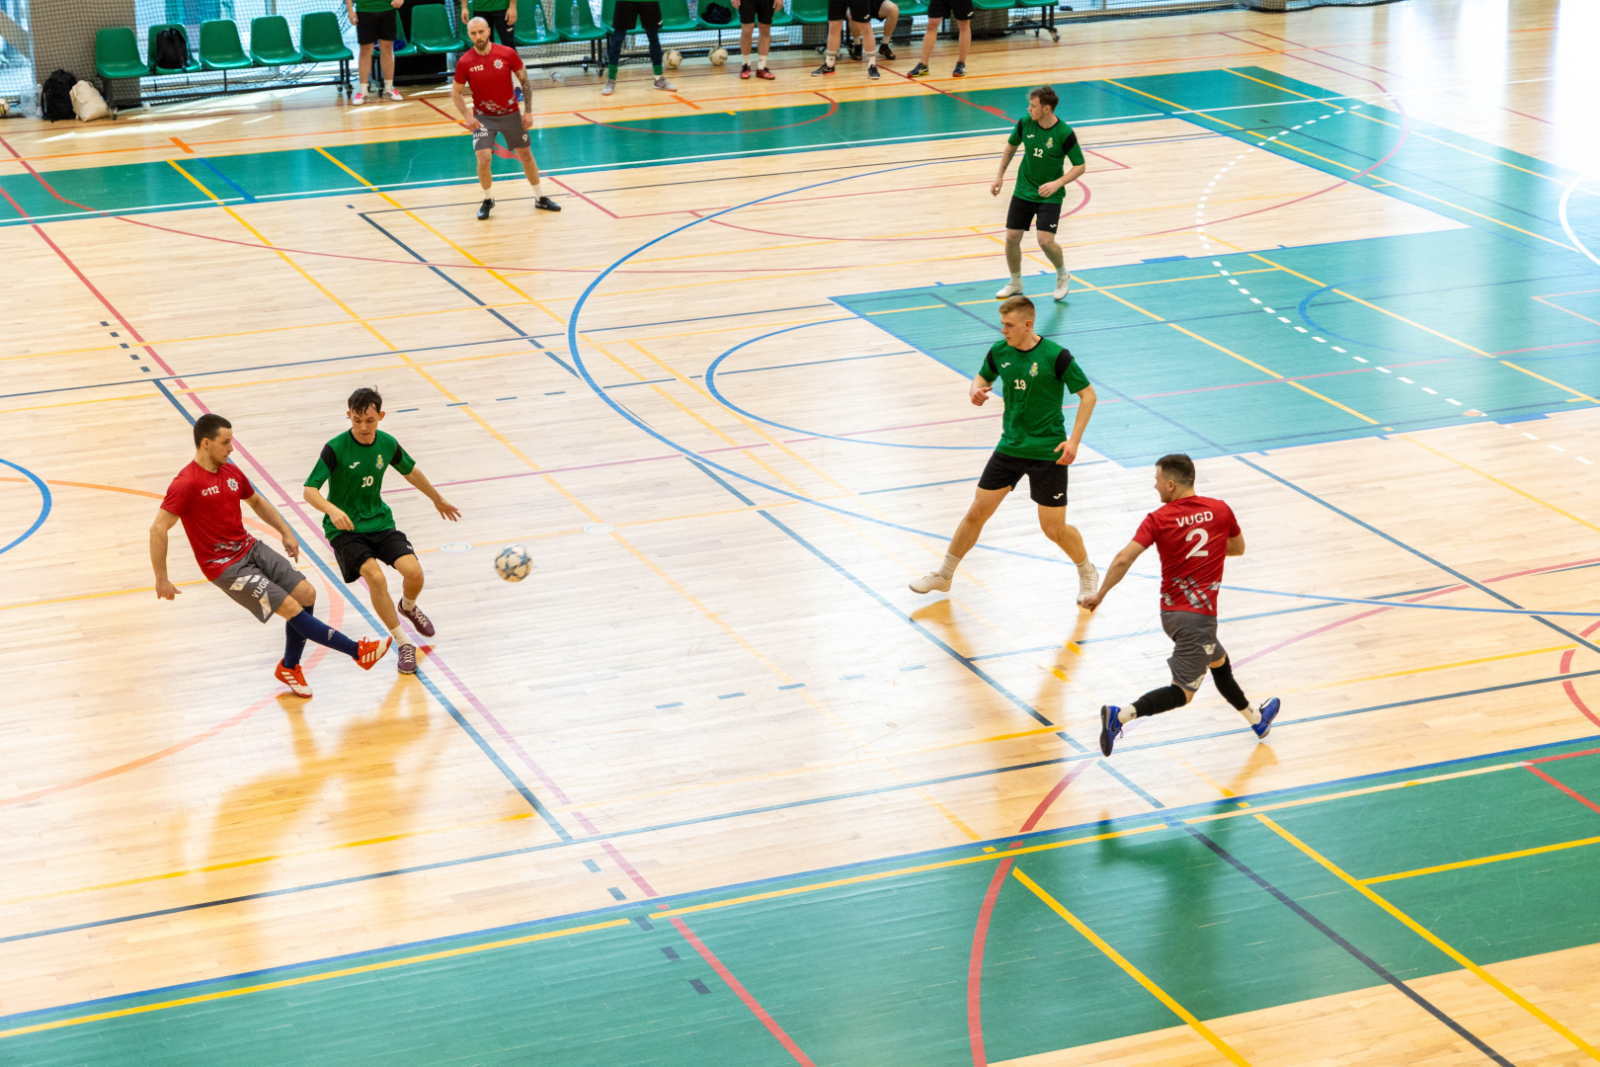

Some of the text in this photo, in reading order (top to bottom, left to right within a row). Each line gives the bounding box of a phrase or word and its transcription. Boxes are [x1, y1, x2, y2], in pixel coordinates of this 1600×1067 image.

[522, 133, 528, 142] 9
[1033, 148, 1044, 158] 12
[1014, 379, 1026, 390] 19
[361, 476, 373, 488] 10
[1176, 511, 1213, 527] VUGD
[1185, 528, 1208, 560] 2
[252, 577, 270, 599] VUGD
